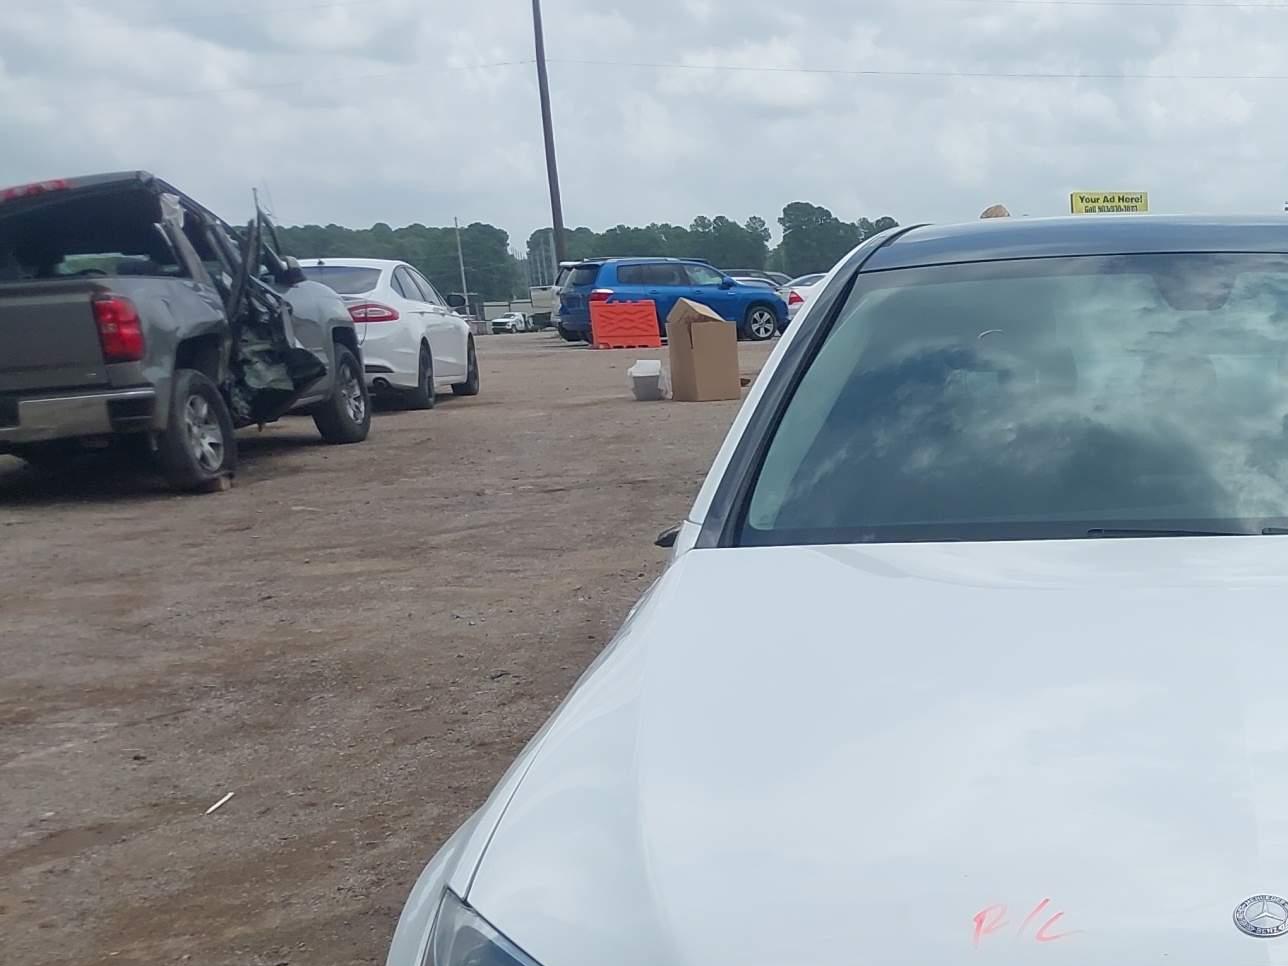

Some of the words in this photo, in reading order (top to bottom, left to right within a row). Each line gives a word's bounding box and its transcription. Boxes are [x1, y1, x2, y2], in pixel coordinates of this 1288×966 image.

[1079, 195, 1100, 204] Your
[1103, 195, 1115, 203] Ad
[1118, 194, 1143, 203] Here!
